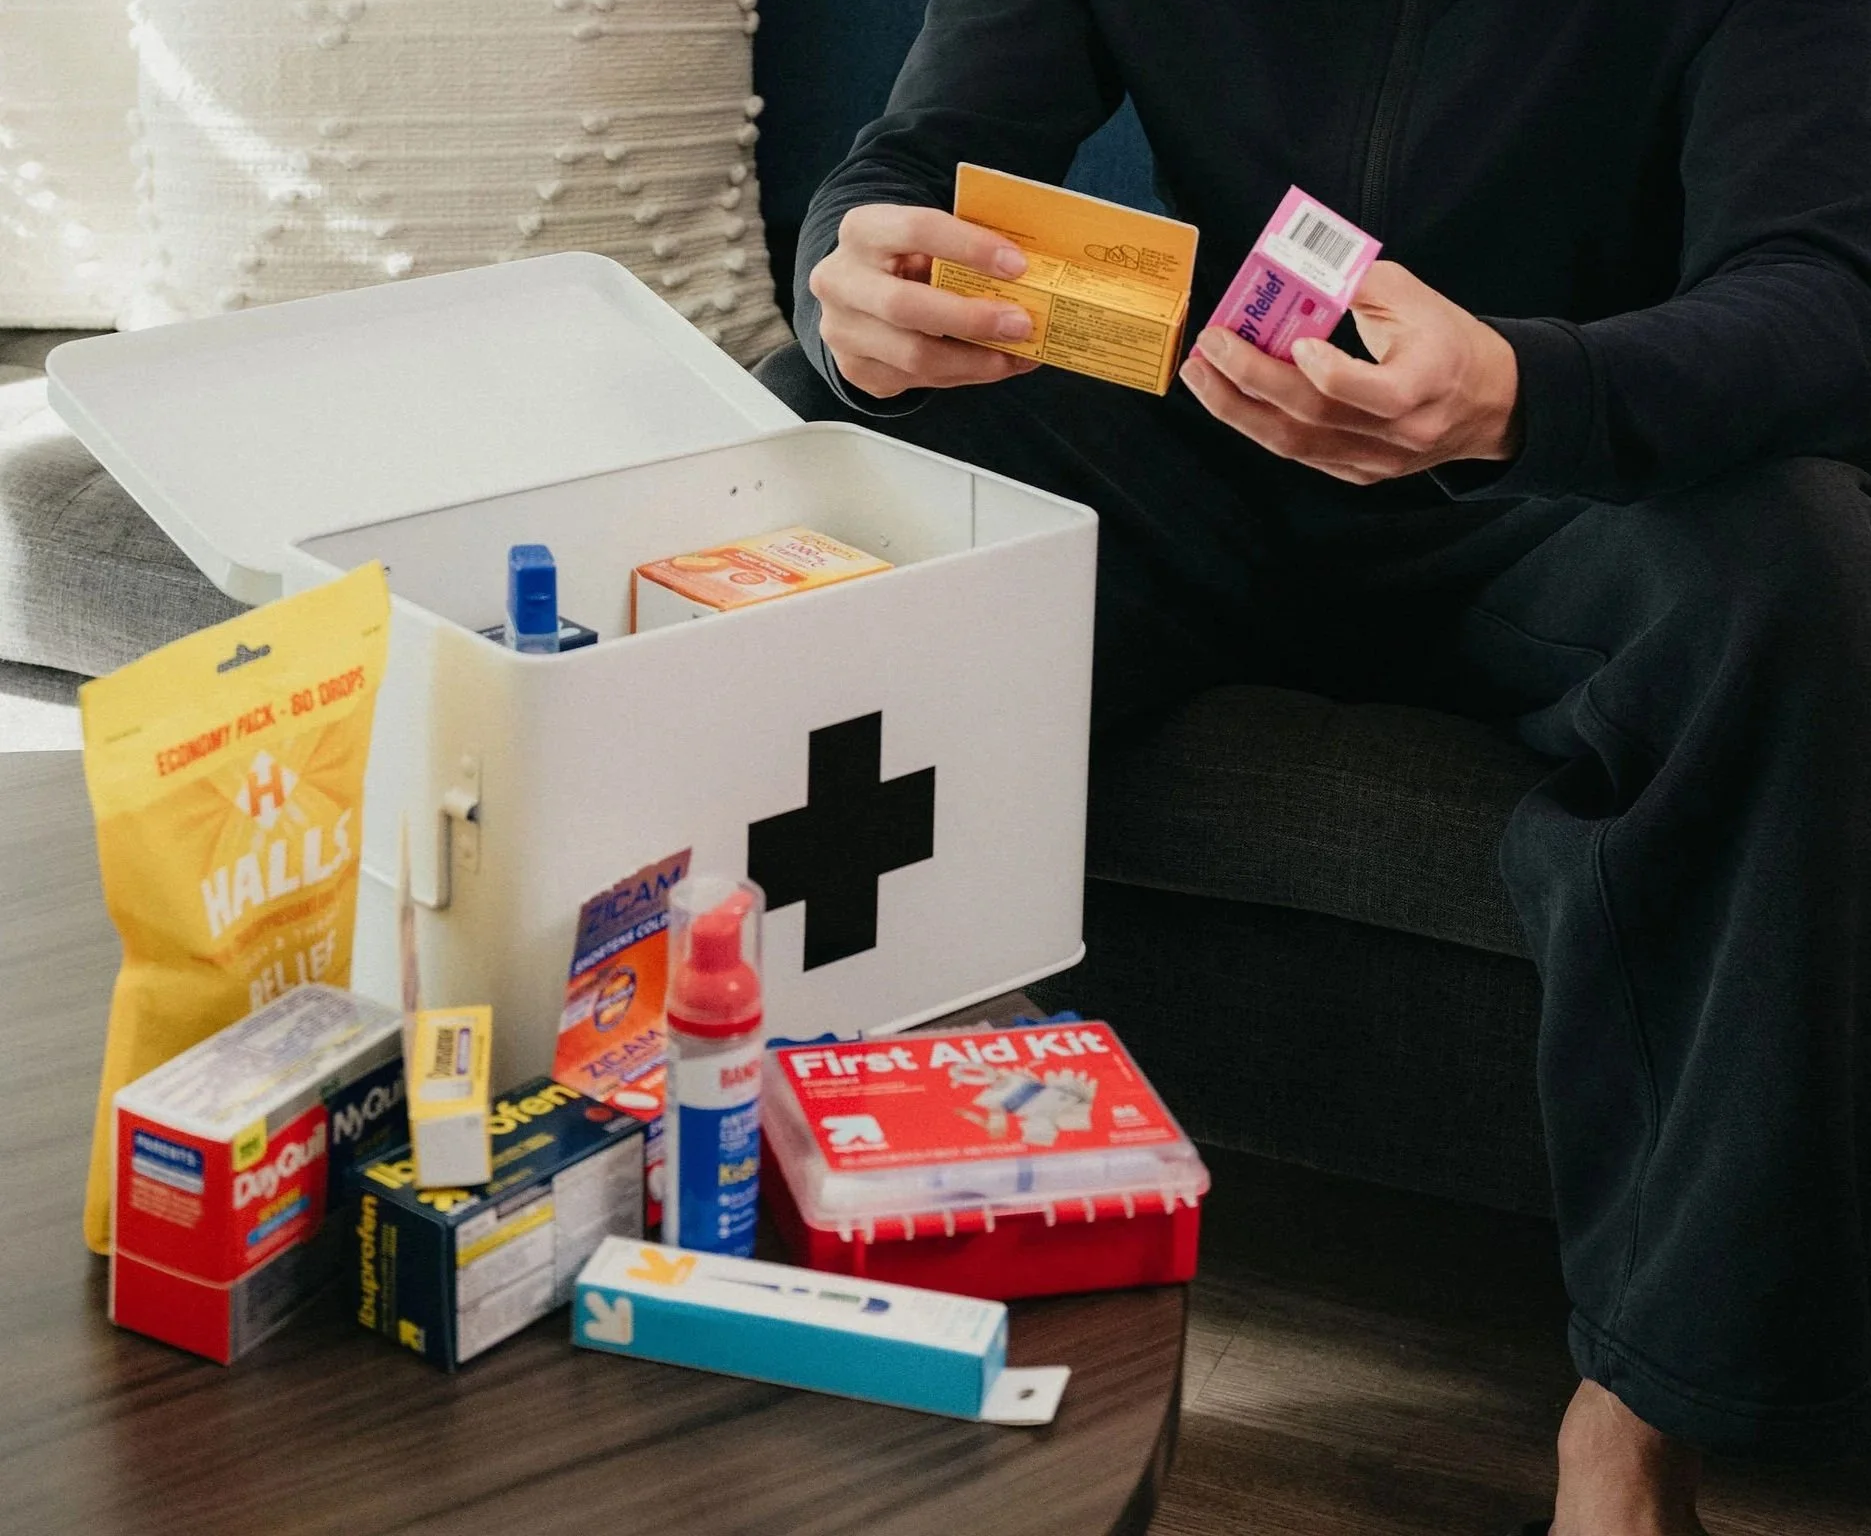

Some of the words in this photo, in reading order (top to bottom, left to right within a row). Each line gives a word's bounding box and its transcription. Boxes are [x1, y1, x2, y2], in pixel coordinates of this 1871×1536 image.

[1243, 269, 1286, 323] Relief
[155, 725, 231, 777] ECONOMY
[236, 702, 276, 739] PACK
[290, 688, 315, 717] 80
[318, 666, 365, 706] DROPS
[247, 762, 286, 818] H
[200, 807, 352, 941] HALLS
[585, 866, 681, 934] ZICAM
[250, 928, 338, 1010] RELIEF
[579, 1029, 661, 1080] ZICAM
[788, 1047, 919, 1080] First
[928, 1035, 1018, 1071] Aid
[1024, 1028, 1110, 1061] Kit
[332, 1070, 405, 1145] NyQu
[232, 1121, 327, 1211] DayQuil
[356, 1193, 379, 1329] Ibuprofen
